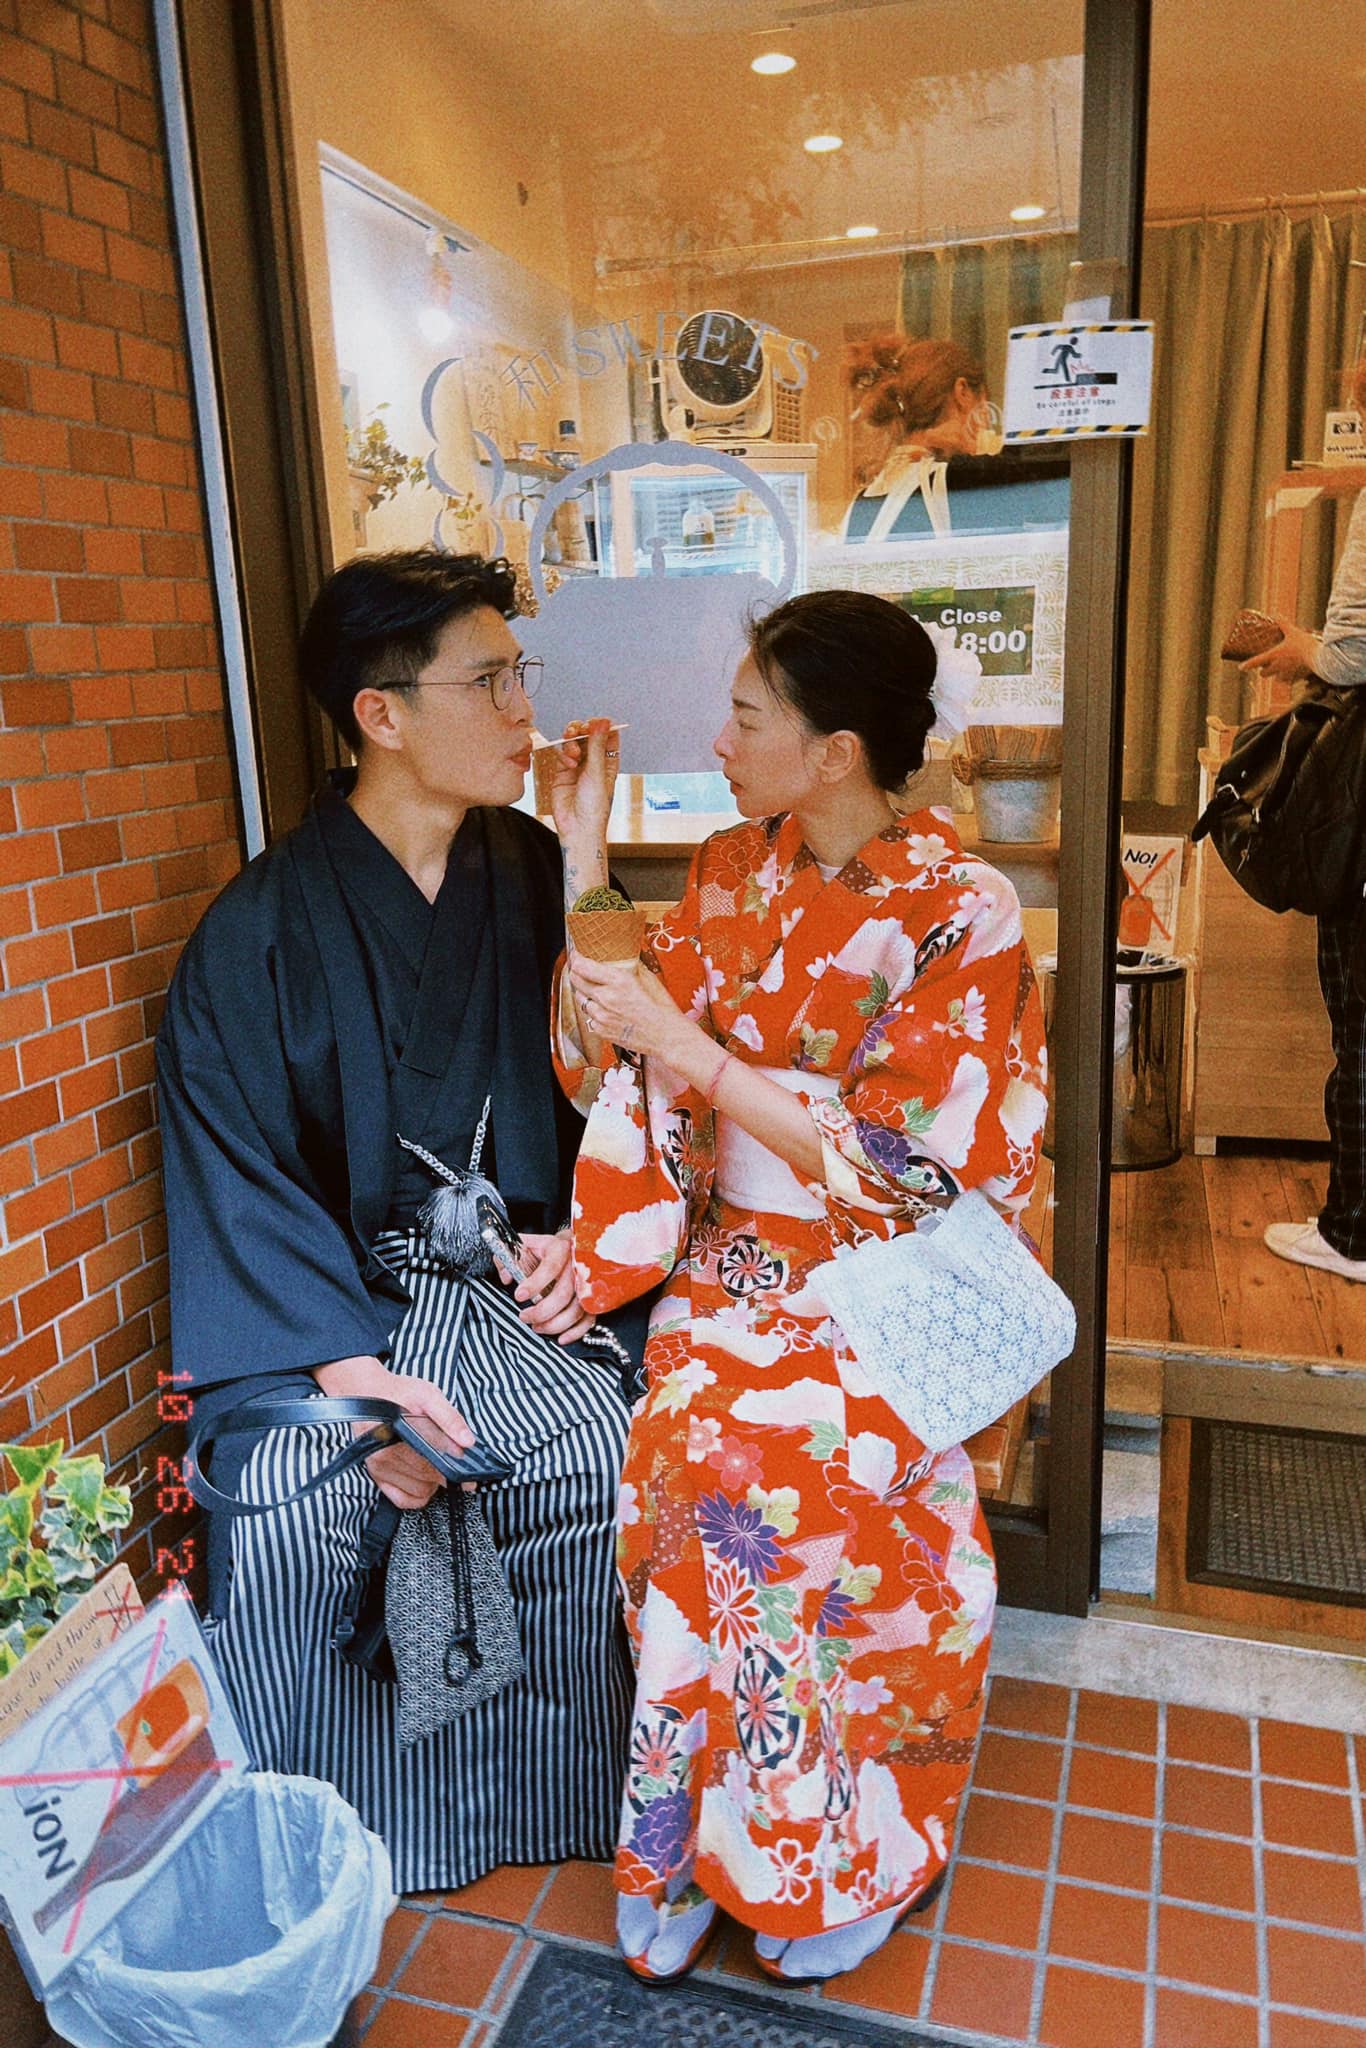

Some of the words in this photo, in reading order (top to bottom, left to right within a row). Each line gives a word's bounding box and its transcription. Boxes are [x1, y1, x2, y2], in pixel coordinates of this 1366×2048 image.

[570, 310, 819, 391] SWEETS
[940, 608, 1002, 626] Close
[1124, 848, 1158, 869] NO!
[28, 1671, 41, 1688] do
[46, 1641, 64, 1672] not
[66, 1615, 97, 1649] throw
[23, 1795, 78, 1881] NO!
